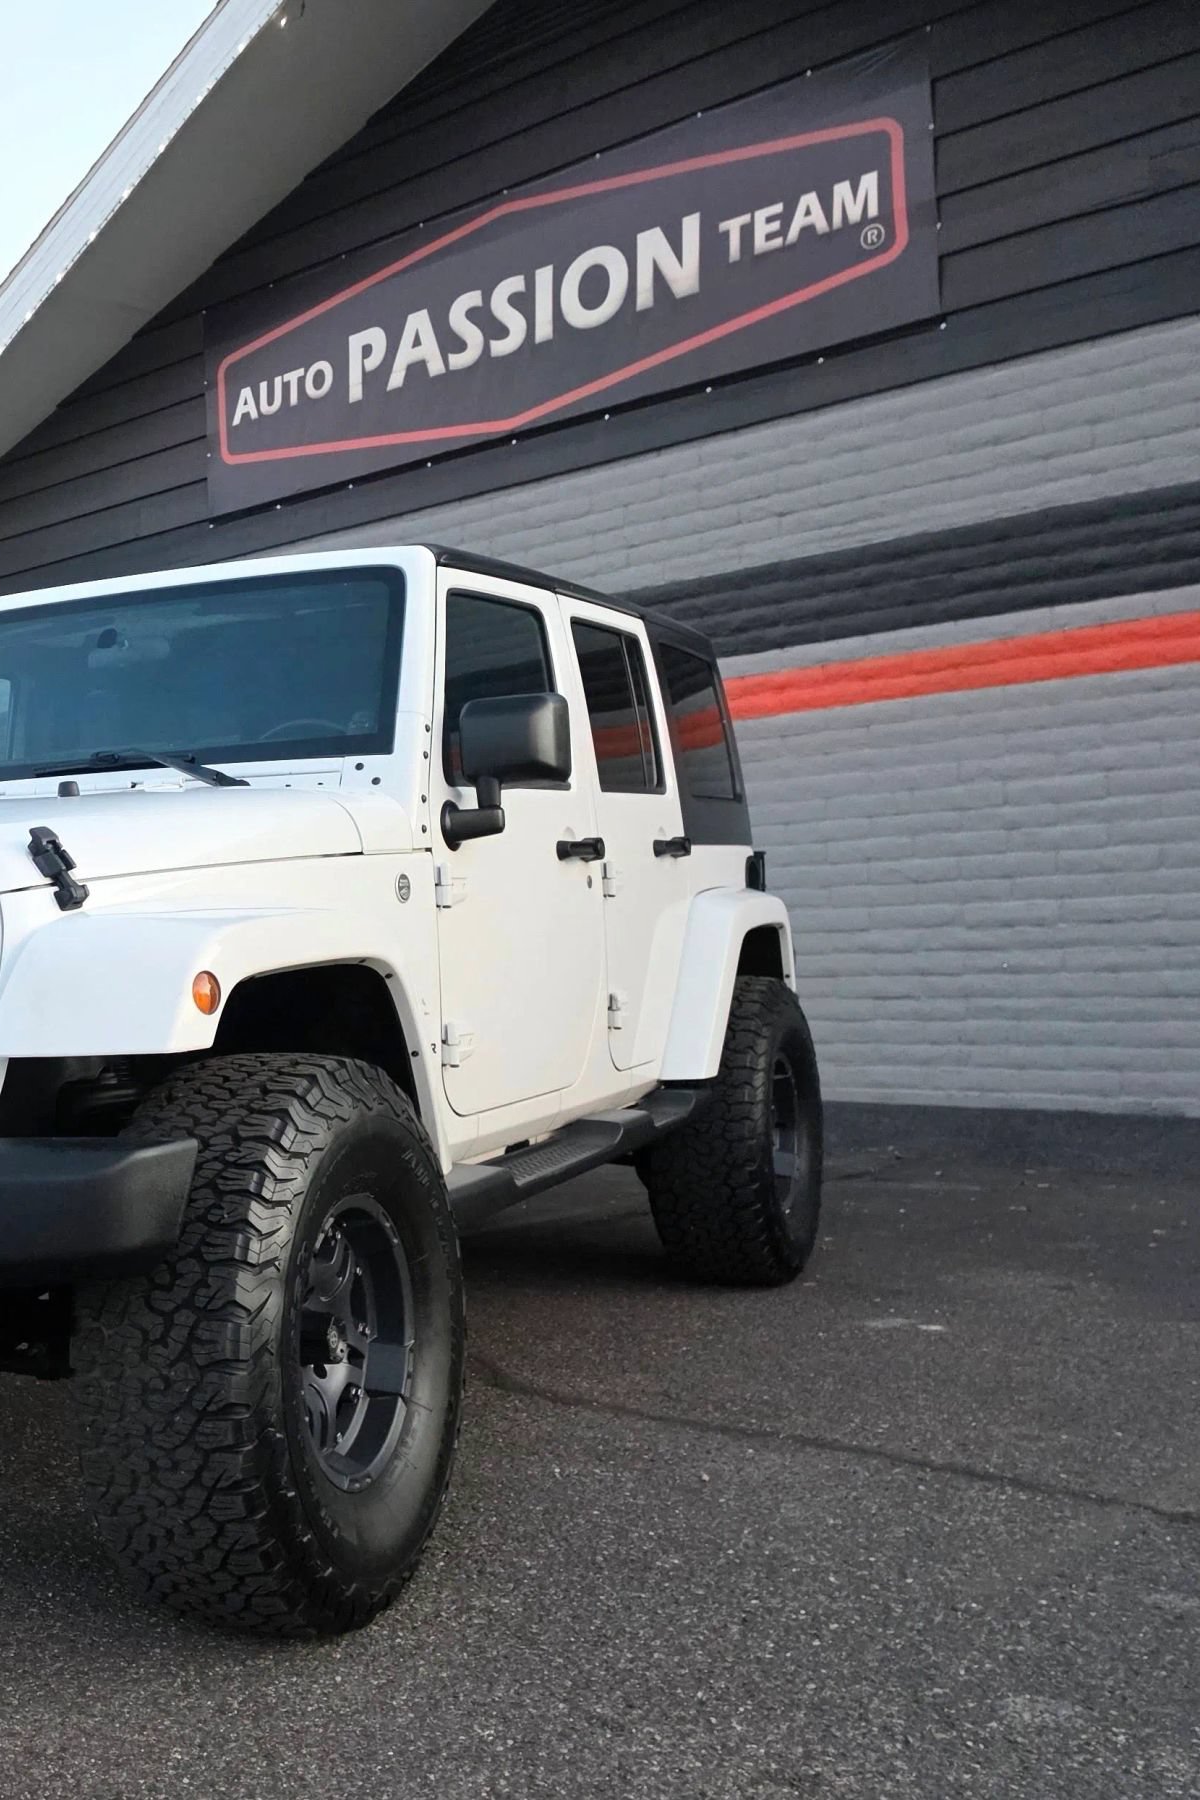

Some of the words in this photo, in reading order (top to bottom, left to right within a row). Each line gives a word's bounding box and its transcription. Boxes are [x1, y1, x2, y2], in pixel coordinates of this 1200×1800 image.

[232, 359, 333, 426] AUTO
[348, 212, 700, 404] PASSION
[718, 170, 880, 263] TEAM
